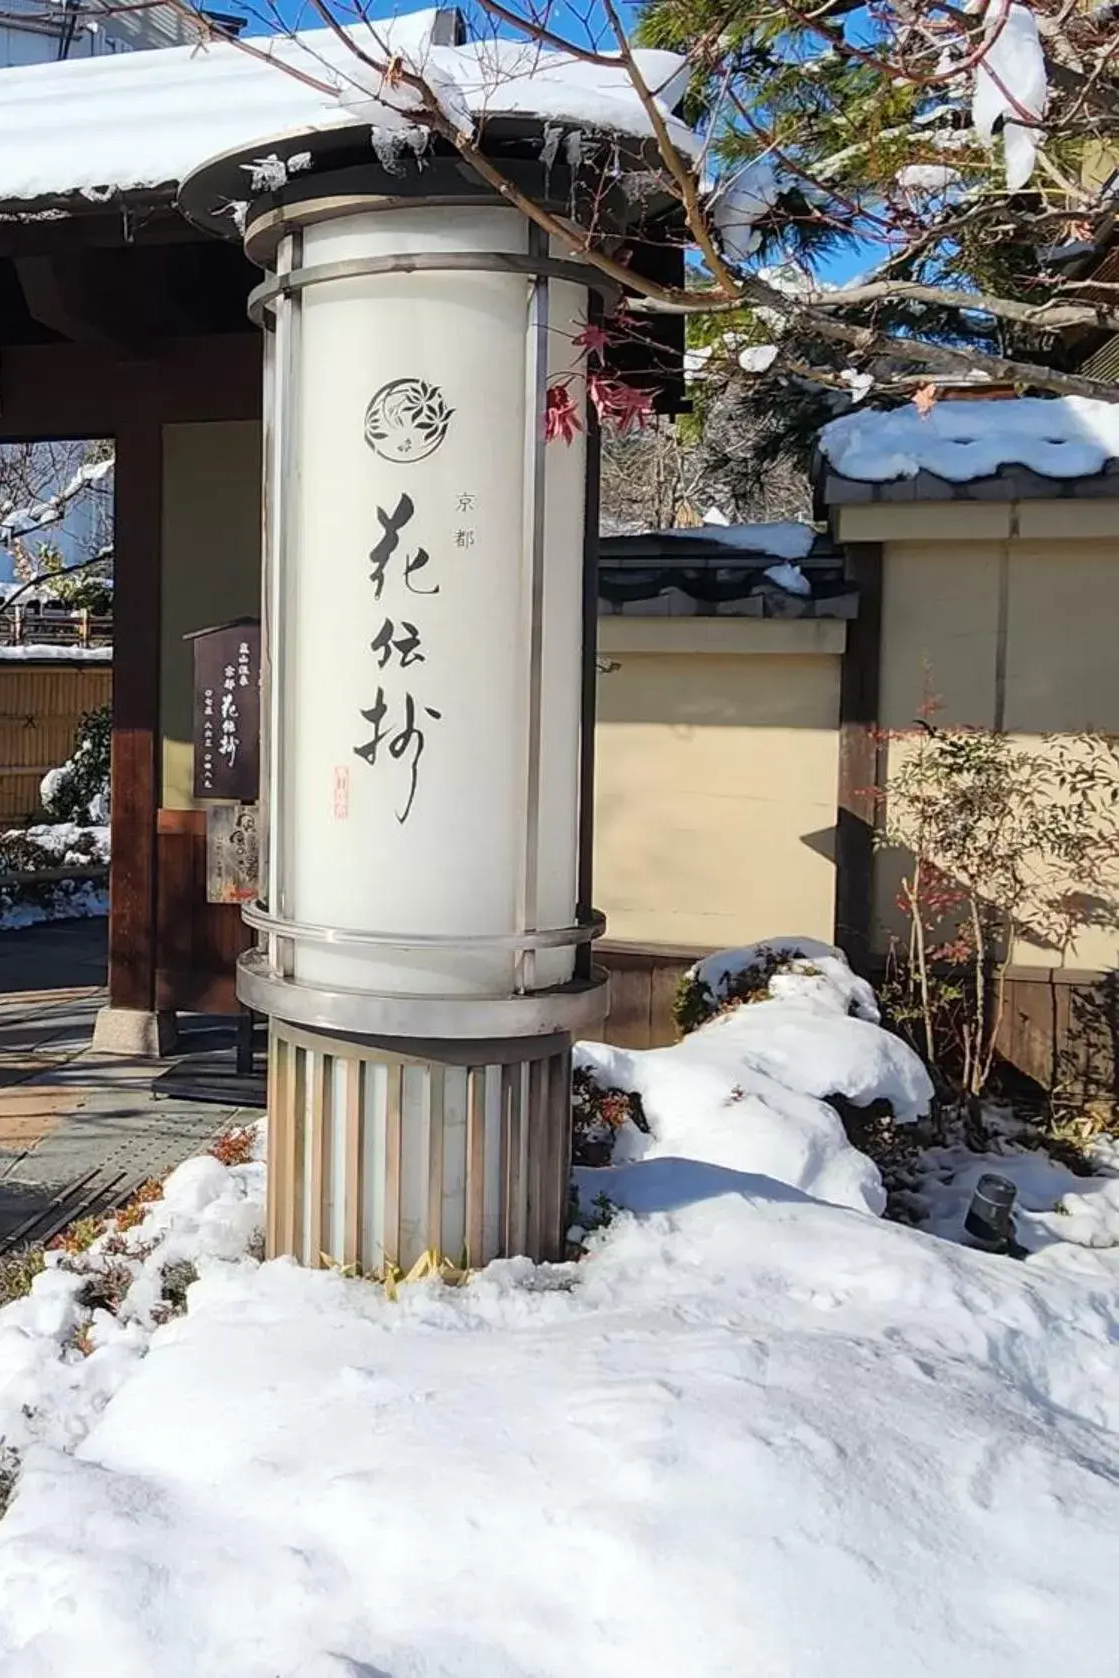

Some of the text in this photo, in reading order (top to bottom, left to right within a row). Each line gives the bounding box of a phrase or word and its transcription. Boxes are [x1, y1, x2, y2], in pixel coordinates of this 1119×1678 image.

[452, 491, 476, 549] 京都
[353, 491, 442, 825] 花伝抄
